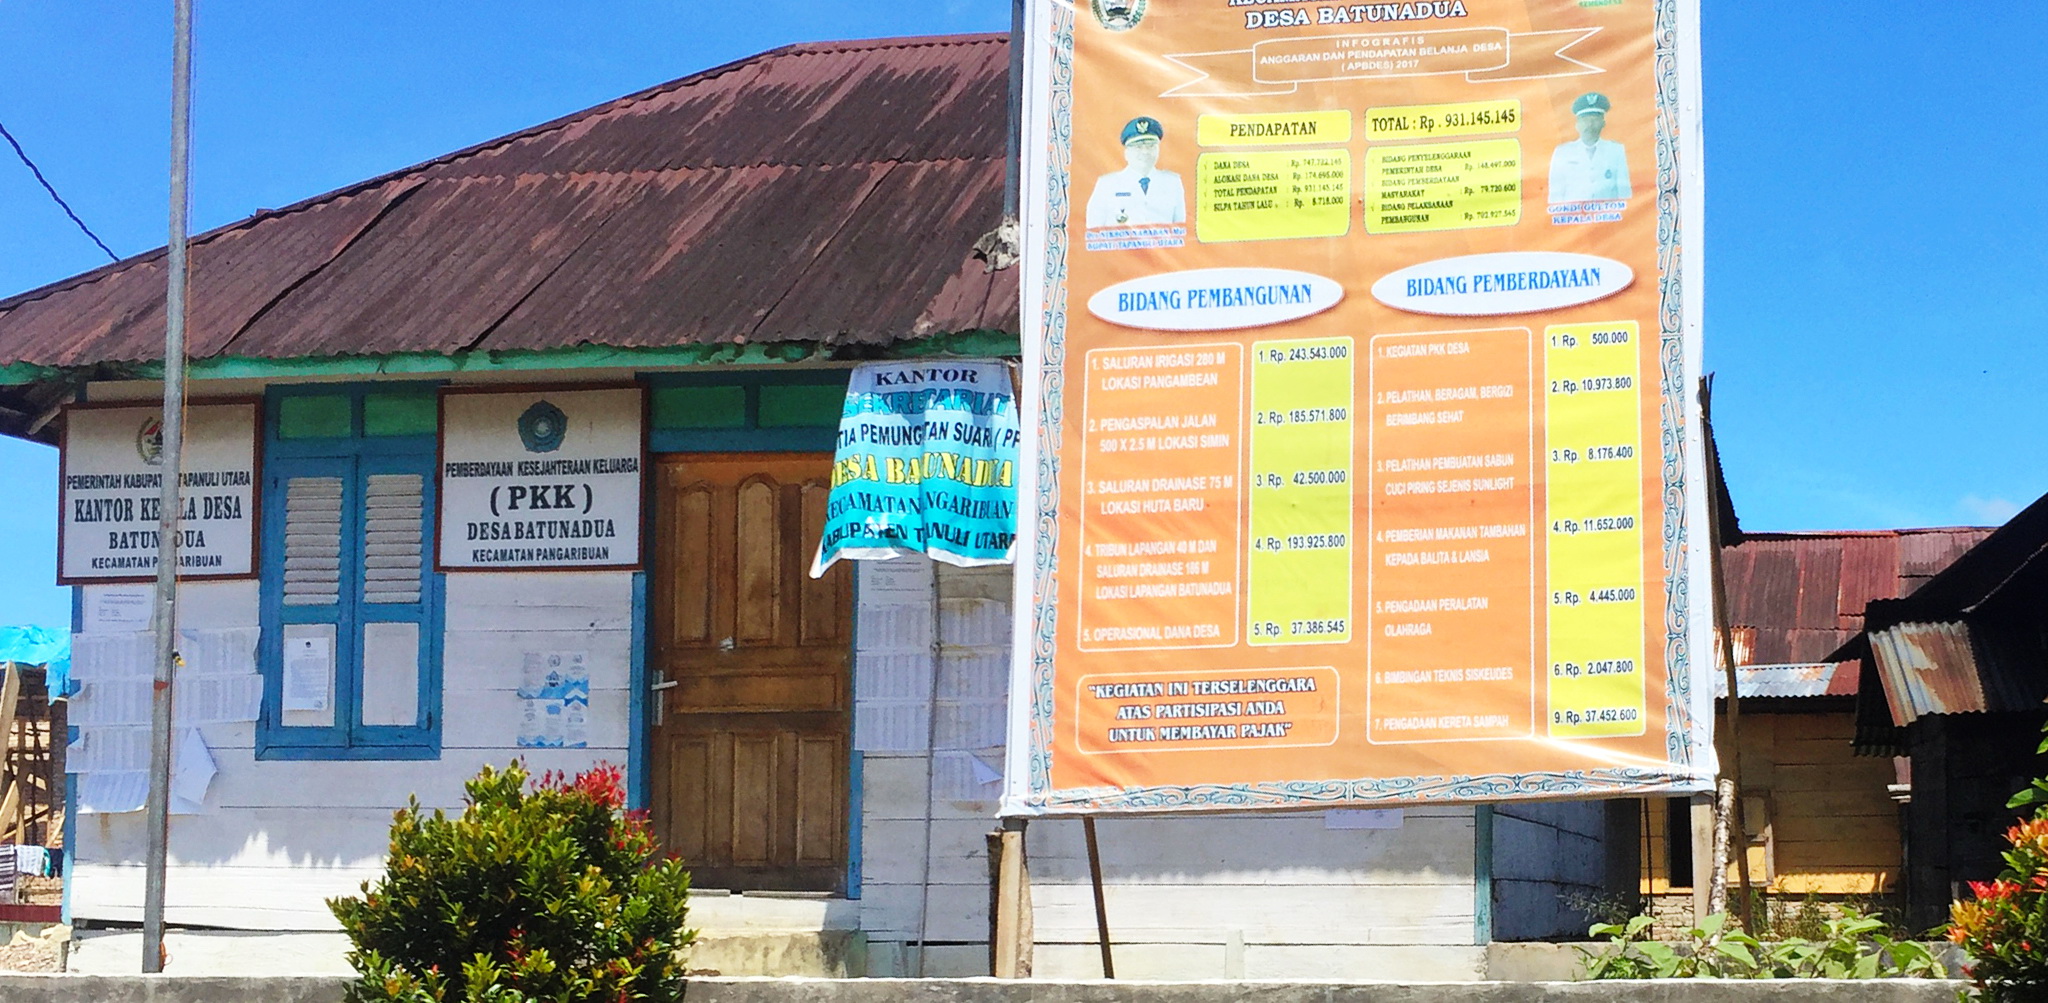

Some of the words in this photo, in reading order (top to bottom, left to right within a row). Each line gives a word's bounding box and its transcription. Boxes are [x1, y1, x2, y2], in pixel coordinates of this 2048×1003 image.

[1245, 10, 1310, 29] DESA
[1318, 0, 1468, 25] BATUNADUA
[1260, 54, 1320, 64] ANGGARAN
[1322, 52, 1345, 61] DAN
[1348, 48, 1416, 60] PENDAPATAN
[1419, 45, 1468, 56] BELANJA
[1473, 42, 1502, 52] DESA
[1396, 59, 1419, 69] 2017
[1230, 121, 1317, 137] PENDAPATAN
[1372, 116, 1409, 132] TOTAL
[1445, 109, 1515, 127] 931.145.145
[1214, 189, 1234, 197] TOTAL
[1236, 186, 1277, 196] PENDAPATAN
[1381, 214, 1429, 224] PEMBANGUNAN
[1406, 276, 1469, 298] BIDANG
[1472, 267, 1601, 295] PEMBERDAYAAN
[1118, 292, 1181, 313] BIDANG
[1187, 284, 1312, 310] PEMBANGUNAN
[1563, 335, 1579, 348] Rp.
[1592, 331, 1628, 345] 500.000
[1270, 349, 1286, 364] Rp.
[1289, 345, 1347, 360] 243.543.000
[1386, 345, 1427, 357] KEGIATAN
[1428, 343, 1445, 356] PKK
[1447, 342, 1470, 355] DESA
[1102, 355, 1153, 369] SALURAN
[1155, 353, 1194, 367] IRIGASI
[1217, 352, 1226, 364] M
[875, 368, 979, 386] KANTOR
[1102, 376, 1141, 390] LOKASI
[1144, 373, 1218, 389] PANGAMBEAN
[1563, 381, 1579, 394] Rp.
[1582, 377, 1632, 391] 10.973.800
[1481, 385, 1513, 398] BERGIZI
[842, 388, 1011, 417] SEKRETARIAT
[1100, 416, 1179, 430] PENGASPALAN
[1182, 414, 1216, 428] JALAN
[1257, 412, 1266, 424] 2.
[1269, 411, 1286, 426] Rp.
[1289, 408, 1347, 423] 185.571.800
[1386, 412, 1436, 426] BERIMBANG
[1437, 410, 1464, 424] SEHAT
[1100, 439, 1118, 452] 500
[1120, 439, 1127, 451] X
[1129, 438, 1145, 450] 2.5
[1146, 437, 1156, 450] M
[1158, 435, 1198, 449] LOKASI
[1200, 434, 1229, 448] SIMIN
[1385, 458, 1431, 472] PELATIHAN
[1433, 456, 1483, 470] PEMBUATAN
[1485, 454, 1514, 467] SABUN
[1564, 450, 1580, 463] Rp.
[1588, 446, 1633, 460] 8.176.400
[446, 461, 513, 477] PEMBERDAYAAN
[517, 459, 590, 476] KESEJAHTERAAN
[593, 458, 638, 473] KELUARGA
[67, 474, 121, 490] PEMERINTAH
[222, 471, 250, 486] UTARA
[1099, 479, 1150, 494] SALURAN
[1152, 476, 1206, 490] DRAINASE
[1210, 476, 1221, 488] 75
[1223, 476, 1233, 488] M
[1268, 473, 1284, 488] Rp.
[1293, 470, 1346, 485] 42.500.000
[1385, 482, 1406, 496] CUCI
[1407, 480, 1435, 494] PIRING
[1437, 479, 1471, 493] SEJENIS
[1473, 477, 1514, 491] SUNLIGHT
[74, 498, 133, 522] KANTOR
[140, 496, 196, 521] KELA
[203, 496, 242, 519] DESA
[1101, 500, 1141, 515] LOKASI
[1143, 499, 1171, 512] HUTA
[1173, 498, 1204, 511] BARU
[467, 522, 511, 540] DESA
[515, 519, 615, 539] BATUNADUA
[1385, 529, 1434, 543] PEMBERIAN
[1436, 526, 1478, 540] MAKANAN
[1480, 524, 1525, 538] TAMBAHAN
[1565, 520, 1580, 534] Rp.
[1584, 517, 1633, 531] 11.652.000
[109, 530, 205, 549] BATUNDUA
[1095, 543, 1127, 556] TRIBUN
[1129, 542, 1175, 555] LAPANGAN
[1188, 541, 1197, 553] M
[1199, 540, 1216, 552] DAN
[1267, 537, 1282, 552] Rp.
[1287, 534, 1345, 549] 193.925.800
[92, 557, 150, 569] KECAMATAN
[472, 549, 534, 562] KECAMATAN
[536, 547, 608, 560] PANGARIBUAN
[1385, 552, 1419, 566] KEPADA
[1421, 551, 1449, 564] BALITA
[1459, 549, 1490, 563] LANSIA
[1097, 564, 1138, 578] SALURAN
[1140, 562, 1183, 575] DRAINASE
[1096, 586, 1128, 599] LOKASI
[1130, 584, 1177, 597] LAPANGAN
[1179, 582, 1232, 596] BATUNADUA
[1565, 592, 1581, 605] Rp.
[1589, 589, 1635, 602] 4.445.000
[1385, 598, 1438, 614] PENGADAAN
[1439, 597, 1488, 611] PERALATAN
[1094, 626, 1162, 641] OPERASIONAL
[1164, 625, 1190, 639] DANA
[1193, 624, 1220, 637] DESA
[1265, 622, 1282, 637] Rp.
[1291, 620, 1345, 635] 37.386.545
[1385, 624, 1432, 637] OLAHRAGA
[1384, 670, 1431, 684] BIMBINGAN
[1433, 669, 1463, 682] TEKNIS
[1465, 667, 1513, 681] SISKEUDES
[1566, 663, 1582, 677] Rp.
[1587, 660, 1633, 675] 2.047.800
[1168, 681, 1188, 695] INI
[1193, 677, 1316, 694] TERSELENGGARA
[1116, 705, 1151, 720] ATAS
[1155, 702, 1241, 718] PARTISIPASI
[1245, 700, 1285, 715] ANDA
[1566, 711, 1582, 725] Rp.
[1585, 709, 1636, 722] 37.452.600
[1383, 717, 1436, 731] PENGADAAN
[1439, 716, 1473, 729] KERETA
[1474, 715, 1508, 728] SAMPAH
[1108, 727, 1155, 743] UNTUK
[1159, 724, 1236, 741] MEMBAYAR
